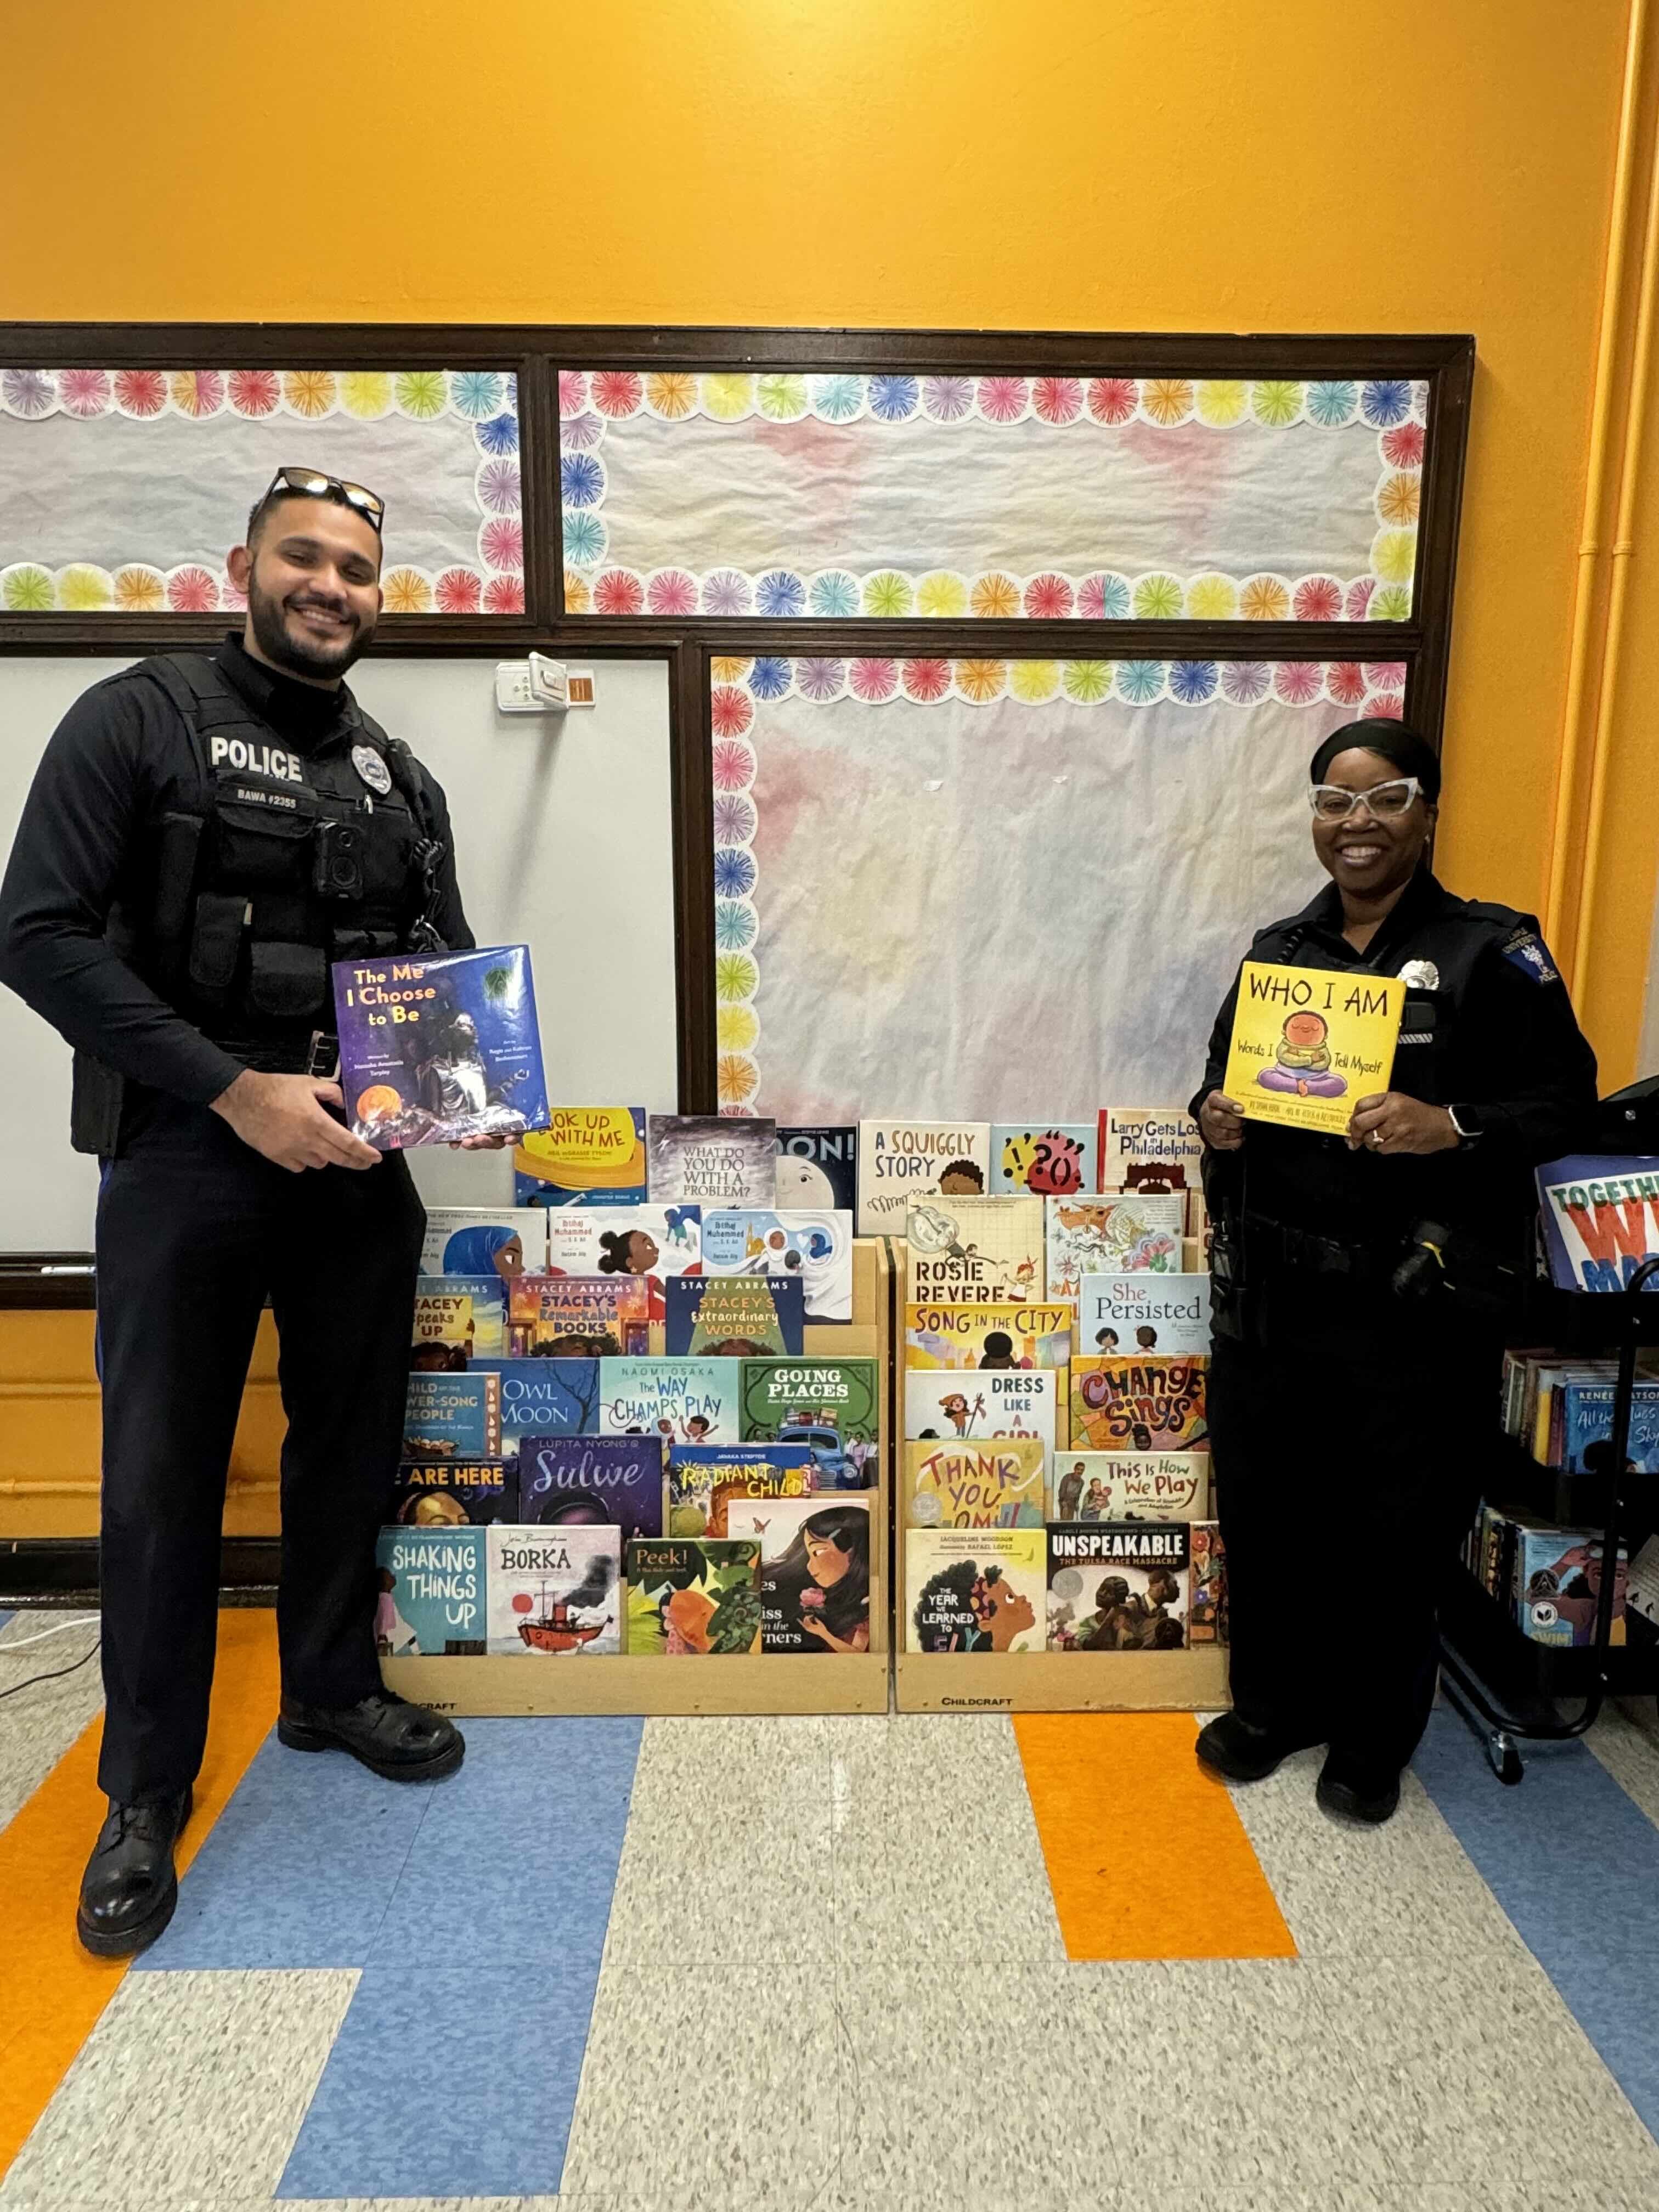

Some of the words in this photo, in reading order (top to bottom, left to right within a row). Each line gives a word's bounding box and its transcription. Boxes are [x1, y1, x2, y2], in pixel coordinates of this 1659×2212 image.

[211, 736, 303, 782] POLICE
[238, 789, 266, 803] BAWA
[354, 969, 386, 984] The
[393, 963, 425, 981] Me
[347, 989, 354, 1006] I
[360, 987, 436, 1005] Choose
[1250, 973, 1312, 1006] WHO
[1323, 982, 1336, 1009] I
[1344, 986, 1387, 1017] AM
[369, 1013, 386, 1026] to
[392, 1005, 420, 1024] Be
[1238, 1039, 1265, 1057] Words
[1268, 1043, 1273, 1057] I
[1334, 1052, 1348, 1069] Tell
[1351, 1060, 1384, 1076] Myself
[586, 1114, 610, 1131] UP
[1111, 1118, 1144, 1139] Larry
[1146, 1120, 1176, 1136] Gets
[1178, 1119, 1200, 1136] Los
[550, 1129, 594, 1146] WITH
[599, 1130, 625, 1148] ME
[875, 1131, 885, 1150] A
[891, 1130, 975, 1156] SQUIGGLY
[683, 1146, 721, 1158] WHAT
[725, 1148, 744, 1159] DO
[1120, 1136, 1201, 1161] Philadelphia
[683, 1158, 716, 1171] YOU
[720, 1159, 744, 1171] DO
[875, 1154, 935, 1178] STORY
[683, 1171, 729, 1184] WITH
[733, 1172, 744, 1185] A
[683, 1185, 751, 1197] PROBLEM?
[1551, 1175, 1659, 1212] TOGETH
[916, 1261, 984, 1282] ROSIE
[579, 1284, 631, 1293] ABRAMS
[680, 1282, 727, 1290] STACEY
[736, 1282, 788, 1290] ABRAMS
[916, 1285, 1005, 1303] REVERE
[1113, 1282, 1147, 1301] She
[541, 1295, 617, 1307] STACEY'S
[699, 1297, 775, 1308] STACEY'S
[1096, 1296, 1201, 1320] Persisted
[417, 1312, 454, 1325] peaks
[539, 1308, 619, 1321] Remarkable
[691, 1311, 779, 1326] Extraordinary
[915, 1307, 970, 1333] SONG
[974, 1313, 988, 1327] IN
[991, 1316, 1011, 1329] THE
[1015, 1309, 1063, 1334] CITY
[421, 1325, 443, 1336] UP
[554, 1322, 607, 1333] BOOKS
[704, 1324, 767, 1335] WORDS
[621, 1368, 665, 1376] NAOMI
[671, 1367, 714, 1376] OSAKA
[774, 1369, 842, 1383] GOING
[503, 1379, 558, 1401] OWL
[639, 1382, 655, 1393] The
[656, 1376, 688, 1397] WAY
[768, 1384, 849, 1398] PLACES
[991, 1377, 1044, 1393] DRESS
[614, 1398, 678, 1420] CHAMPS
[685, 1395, 722, 1418] PLAY
[1003, 1398, 1031, 1412] LIKE
[1013, 1414, 1022, 1426] A
[1578, 1409, 1597, 1429] All
[539, 1440, 582, 1448] LUPITA
[586, 1439, 639, 1448] NYONG'O
[408, 1468, 449, 1486] ARE
[454, 1467, 504, 1486] HERE
[534, 1449, 646, 1492] Sulwe
[682, 1462, 776, 1491] RADIANT
[920, 1452, 1020, 1489] THANK
[1107, 1462, 1142, 1480] This
[1146, 1463, 1155, 1476] Is
[1159, 1459, 1189, 1475] How
[746, 1478, 804, 1498] CHILD
[949, 1482, 1002, 1511] YOU,
[1125, 1479, 1151, 1495] We
[1154, 1476, 1199, 1509] Play
[1052, 1535, 1184, 1556] UNSPEAKABLE
[501, 1548, 572, 1570] BORKA
[636, 1548, 687, 1565] Peek!
[928, 1594, 959, 1606] YEAR
[445, 1603, 477, 1629] UP
[772, 1620, 789, 1630] the
[922, 1613, 975, 1624] LEARNED
[940, 1624, 952, 1633] TO
